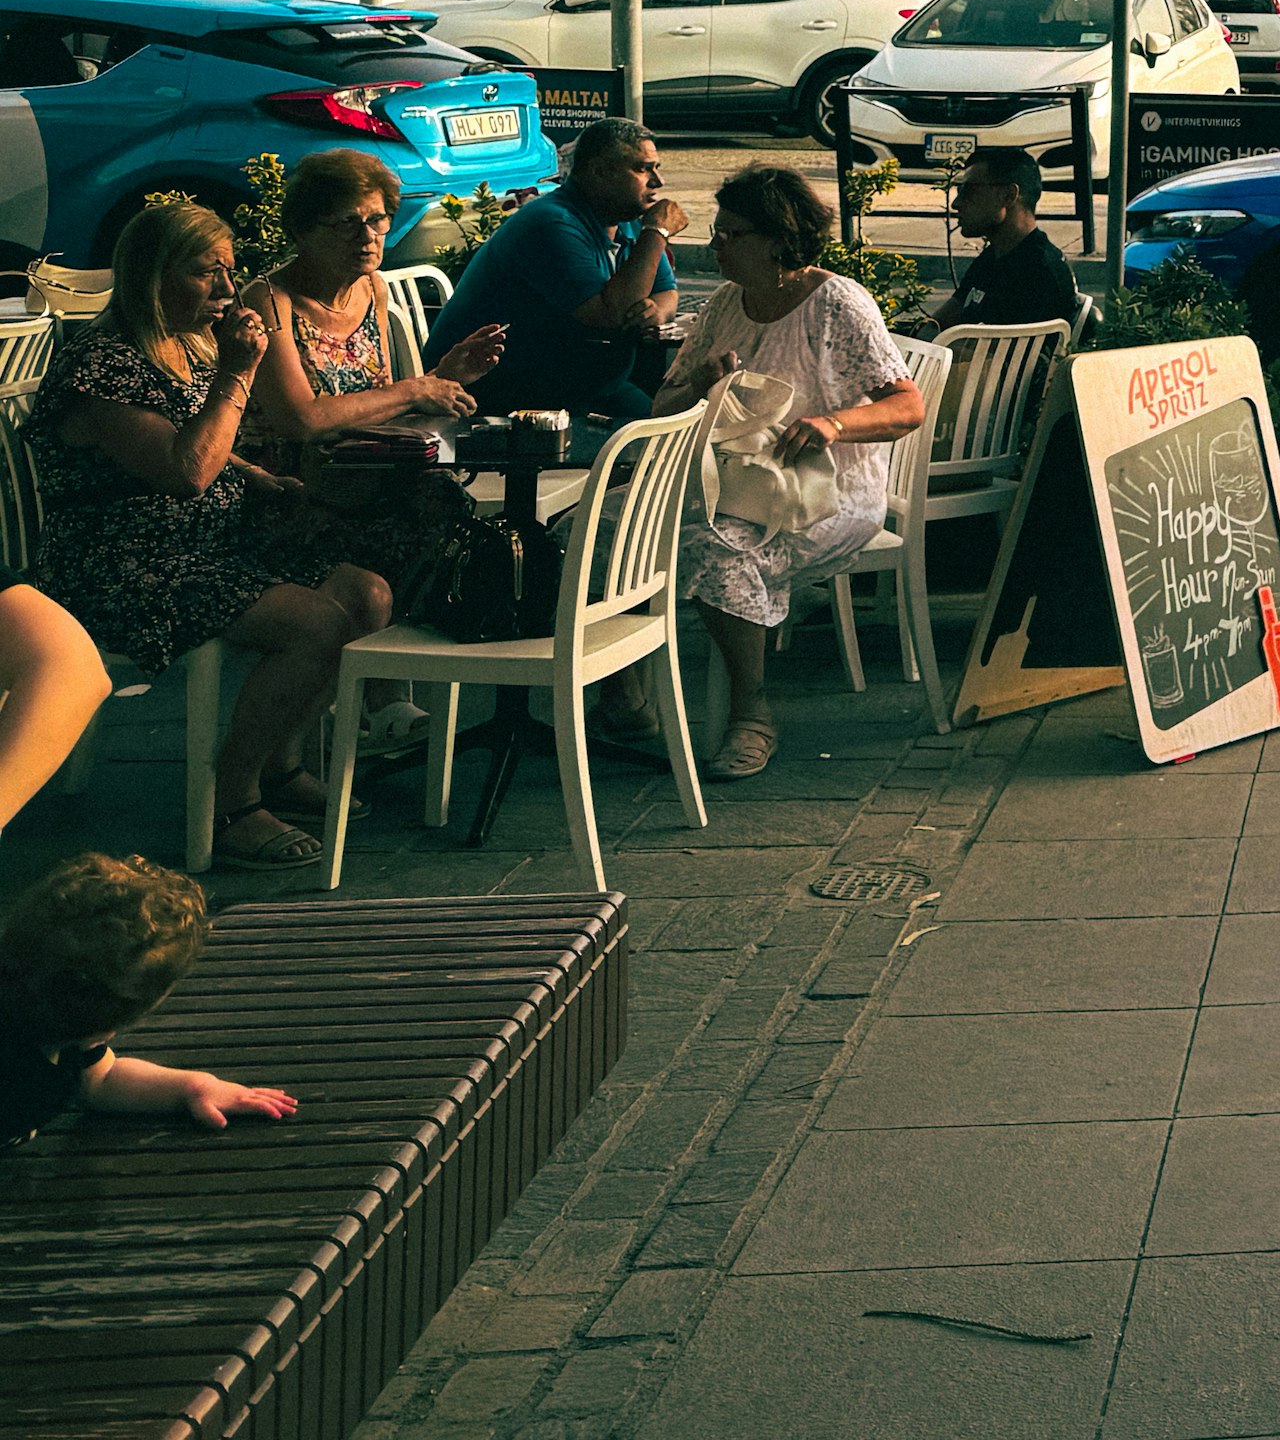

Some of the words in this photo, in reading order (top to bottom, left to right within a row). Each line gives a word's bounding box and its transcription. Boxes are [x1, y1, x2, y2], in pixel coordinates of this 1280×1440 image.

[545, 89, 609, 108] MALTA!
[551, 109, 566, 117] FOR
[567, 109, 606, 119] SHOPPING
[1164, 117, 1241, 128] INTERNETVIKINGS
[456, 117, 485, 137] HLY
[489, 114, 512, 134] 097
[1141, 145, 1231, 164] iGAMING
[1141, 168, 1152, 179] in
[1128, 346, 1218, 415] APEROL
[1148, 477, 1232, 565] Happy
[1161, 557, 1218, 615] Hour
